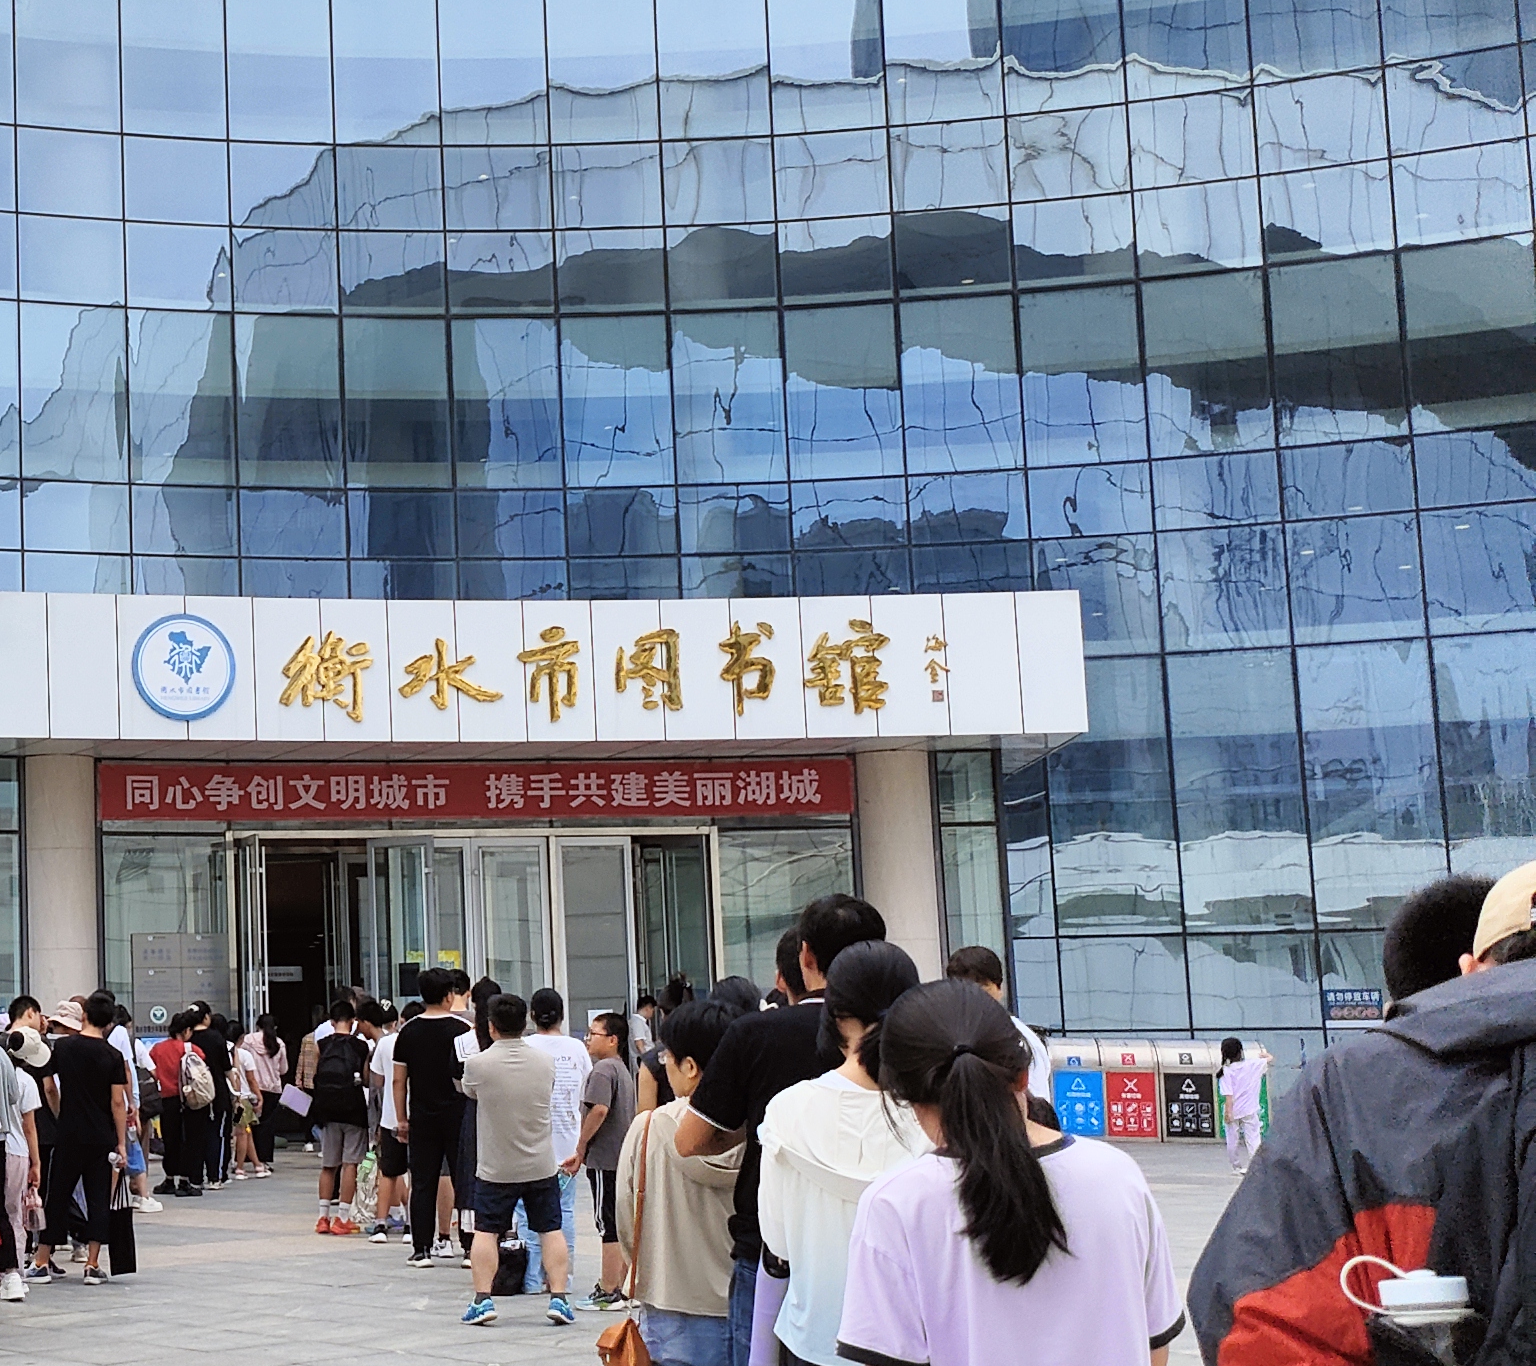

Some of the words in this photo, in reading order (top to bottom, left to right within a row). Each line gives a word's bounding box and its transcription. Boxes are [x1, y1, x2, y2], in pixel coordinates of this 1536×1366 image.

[126, 774, 450, 811] 同心争创文明城市
[485, 768, 822, 809] 携手共建美丽湖城
